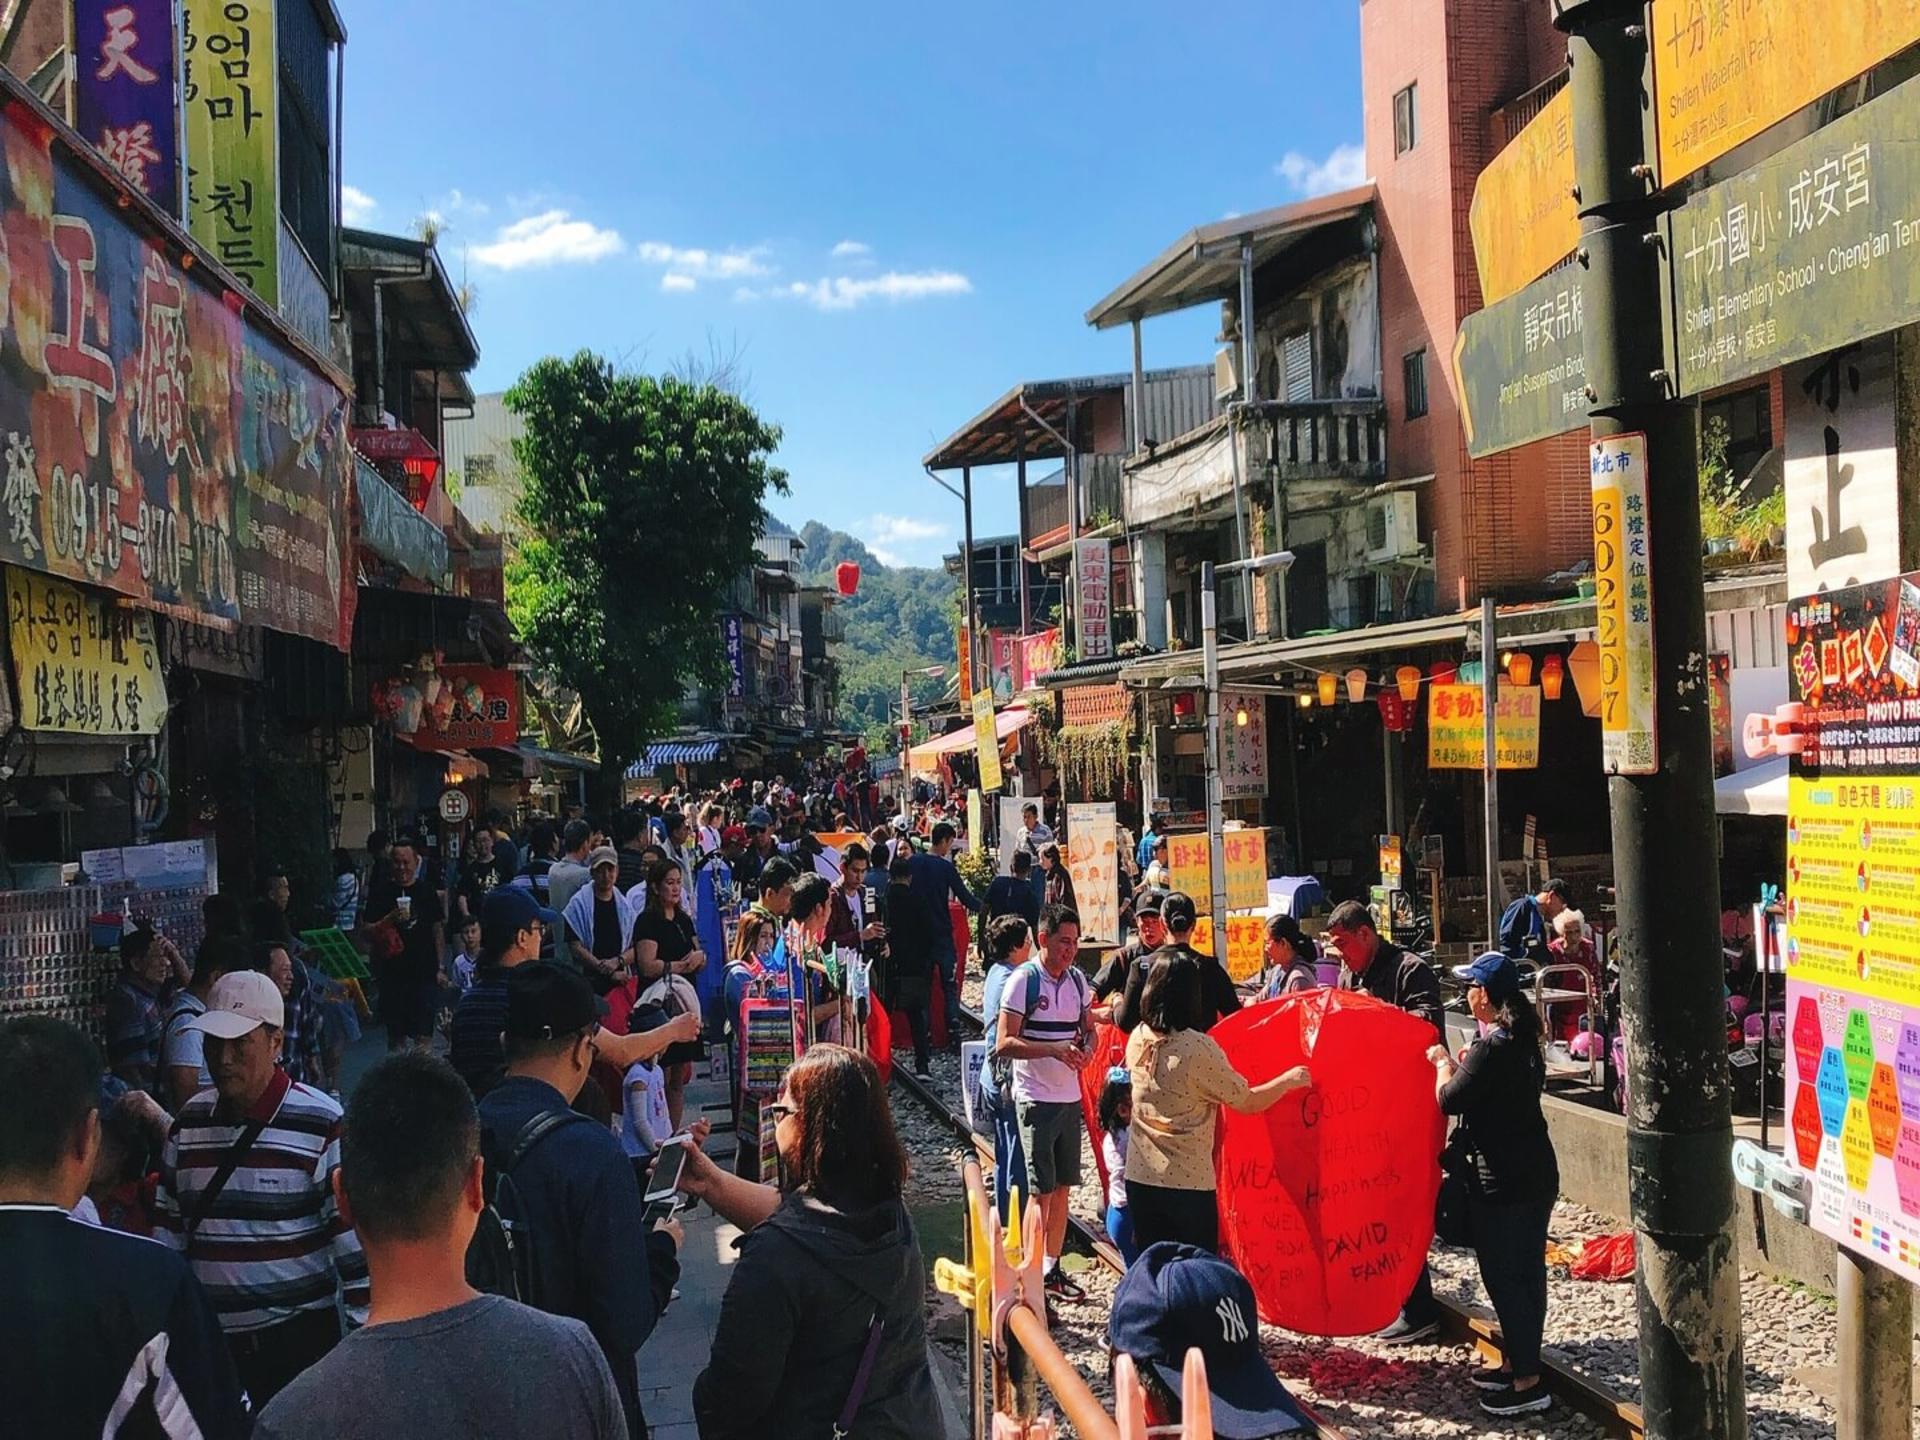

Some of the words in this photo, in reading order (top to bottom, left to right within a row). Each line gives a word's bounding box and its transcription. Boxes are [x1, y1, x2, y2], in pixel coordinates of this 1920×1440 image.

[1669, 82, 1700, 119] Shifen
[1701, 52, 1748, 97] Waterfall
[1749, 31, 1776, 67] Park
[96, 5, 158, 194] 天燈
[1686, 304, 1716, 334] Shifen
[1717, 279, 1776, 320] Elementary
[1777, 258, 1816, 296] School
[1523, 363, 1565, 394] Suspension
[1592, 451, 1631, 474] 新北市
[1626, 494, 1649, 624] 路燈定位編號
[1433, 691, 1536, 719] 電動出租
[1866, 702, 1901, 723] PHOTO
[1327, 1222, 1388, 1263] DAVID
